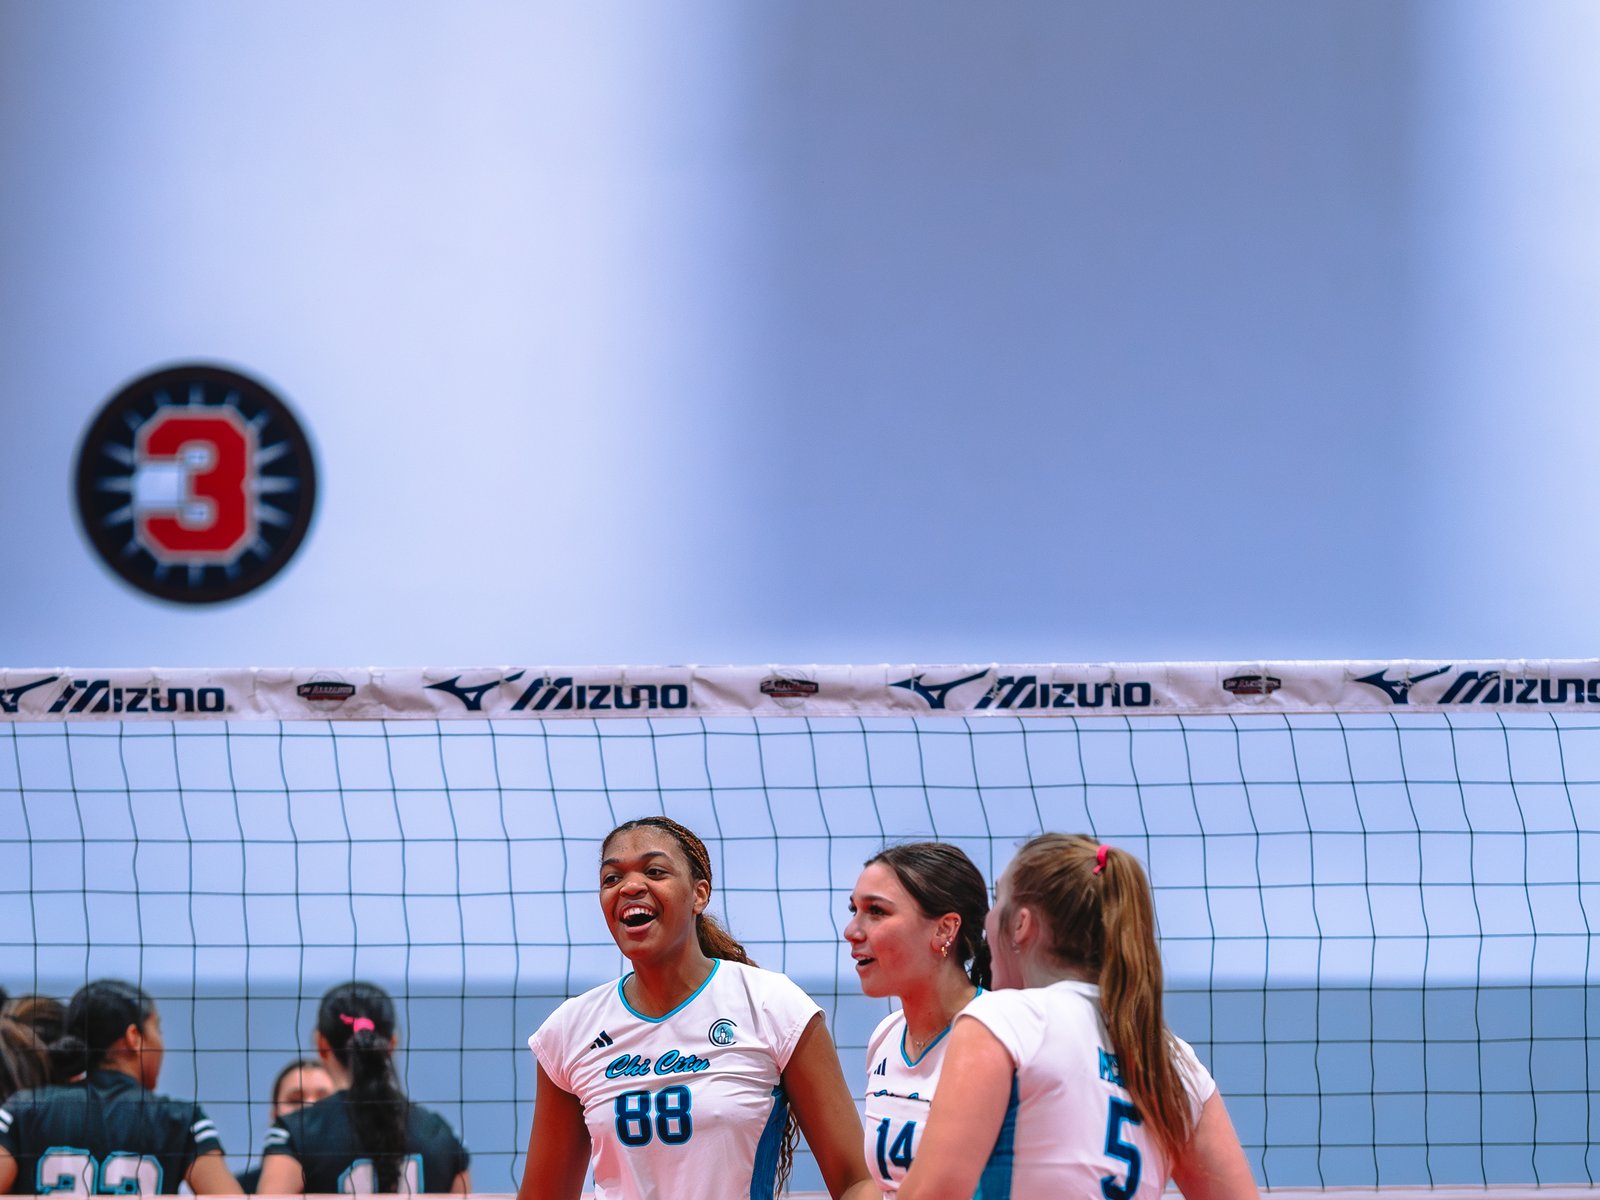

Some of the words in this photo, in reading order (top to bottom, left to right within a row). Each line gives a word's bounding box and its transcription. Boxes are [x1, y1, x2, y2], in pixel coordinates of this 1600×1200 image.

[136, 407, 258, 563] 3
[605, 1053, 652, 1079] Chi
[614, 1084, 693, 1147] 88
[876, 1117, 917, 1181] 14
